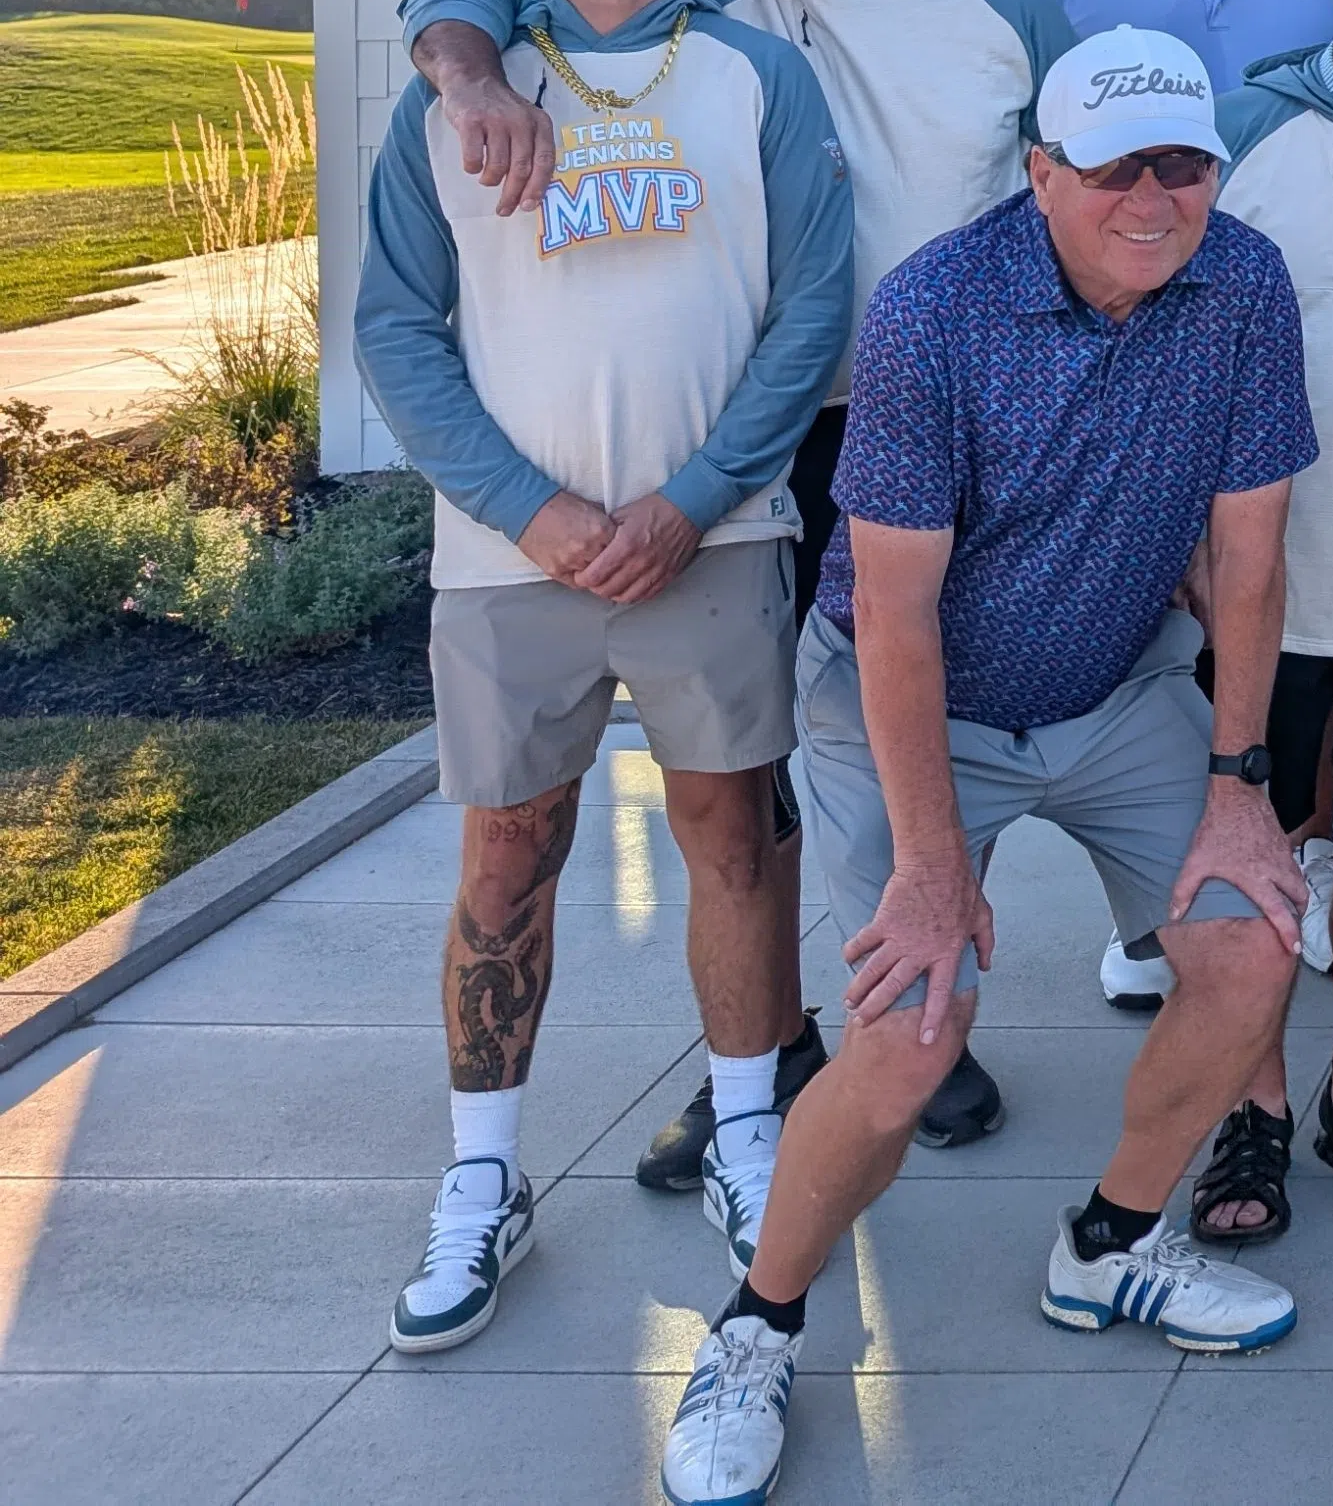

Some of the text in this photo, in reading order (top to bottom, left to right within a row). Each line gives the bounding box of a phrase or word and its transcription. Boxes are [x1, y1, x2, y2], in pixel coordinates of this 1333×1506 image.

[1083, 63, 1206, 110] Titleist
[572, 120, 653, 144] TEAM
[557, 141, 675, 171] JENKINS
[540, 167, 704, 255] MVP
[770, 496, 785, 517] FJ
[480, 817, 537, 843] 1994
